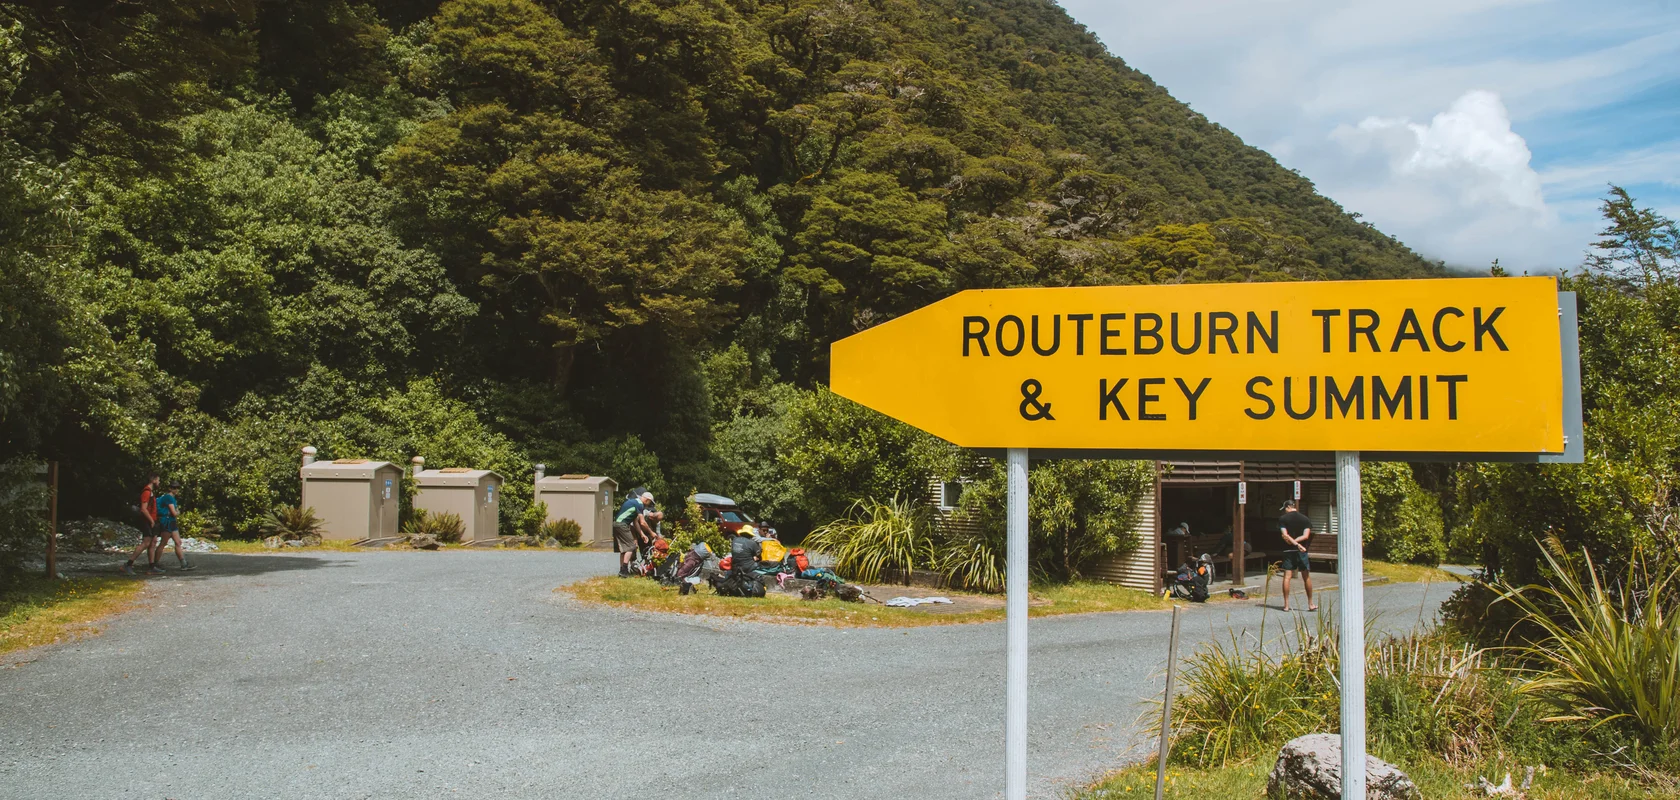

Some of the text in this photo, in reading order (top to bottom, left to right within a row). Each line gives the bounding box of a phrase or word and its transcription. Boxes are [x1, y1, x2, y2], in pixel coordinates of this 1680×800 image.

[962, 306, 1510, 357] ROUTEBURN TRACK
[1019, 374, 1469, 422] & KEY SUMMIT
